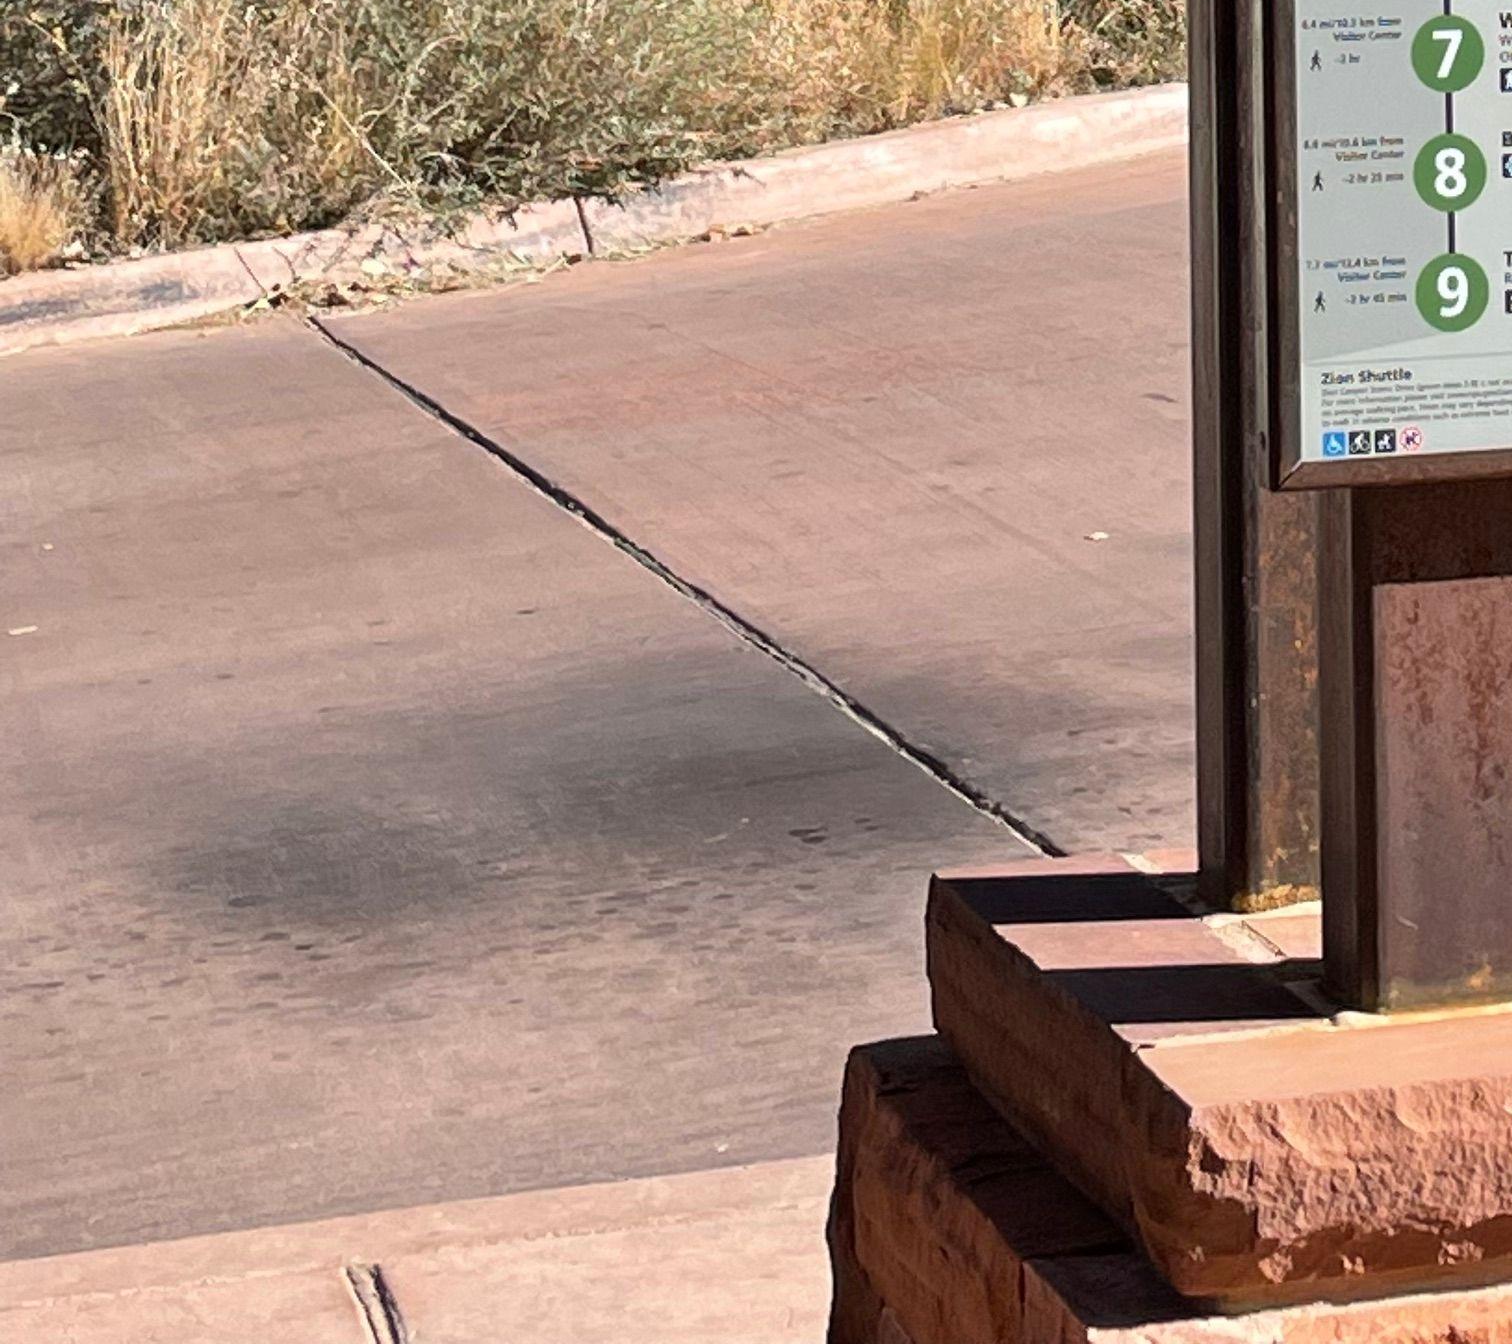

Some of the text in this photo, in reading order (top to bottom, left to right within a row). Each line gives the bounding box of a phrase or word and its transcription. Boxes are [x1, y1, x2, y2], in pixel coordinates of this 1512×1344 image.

[1432, 28, 1463, 78] 7
[1434, 147, 1467, 198] 8
[1437, 265, 1469, 317] 9
[1321, 368, 1412, 384] Zion Shuttle
